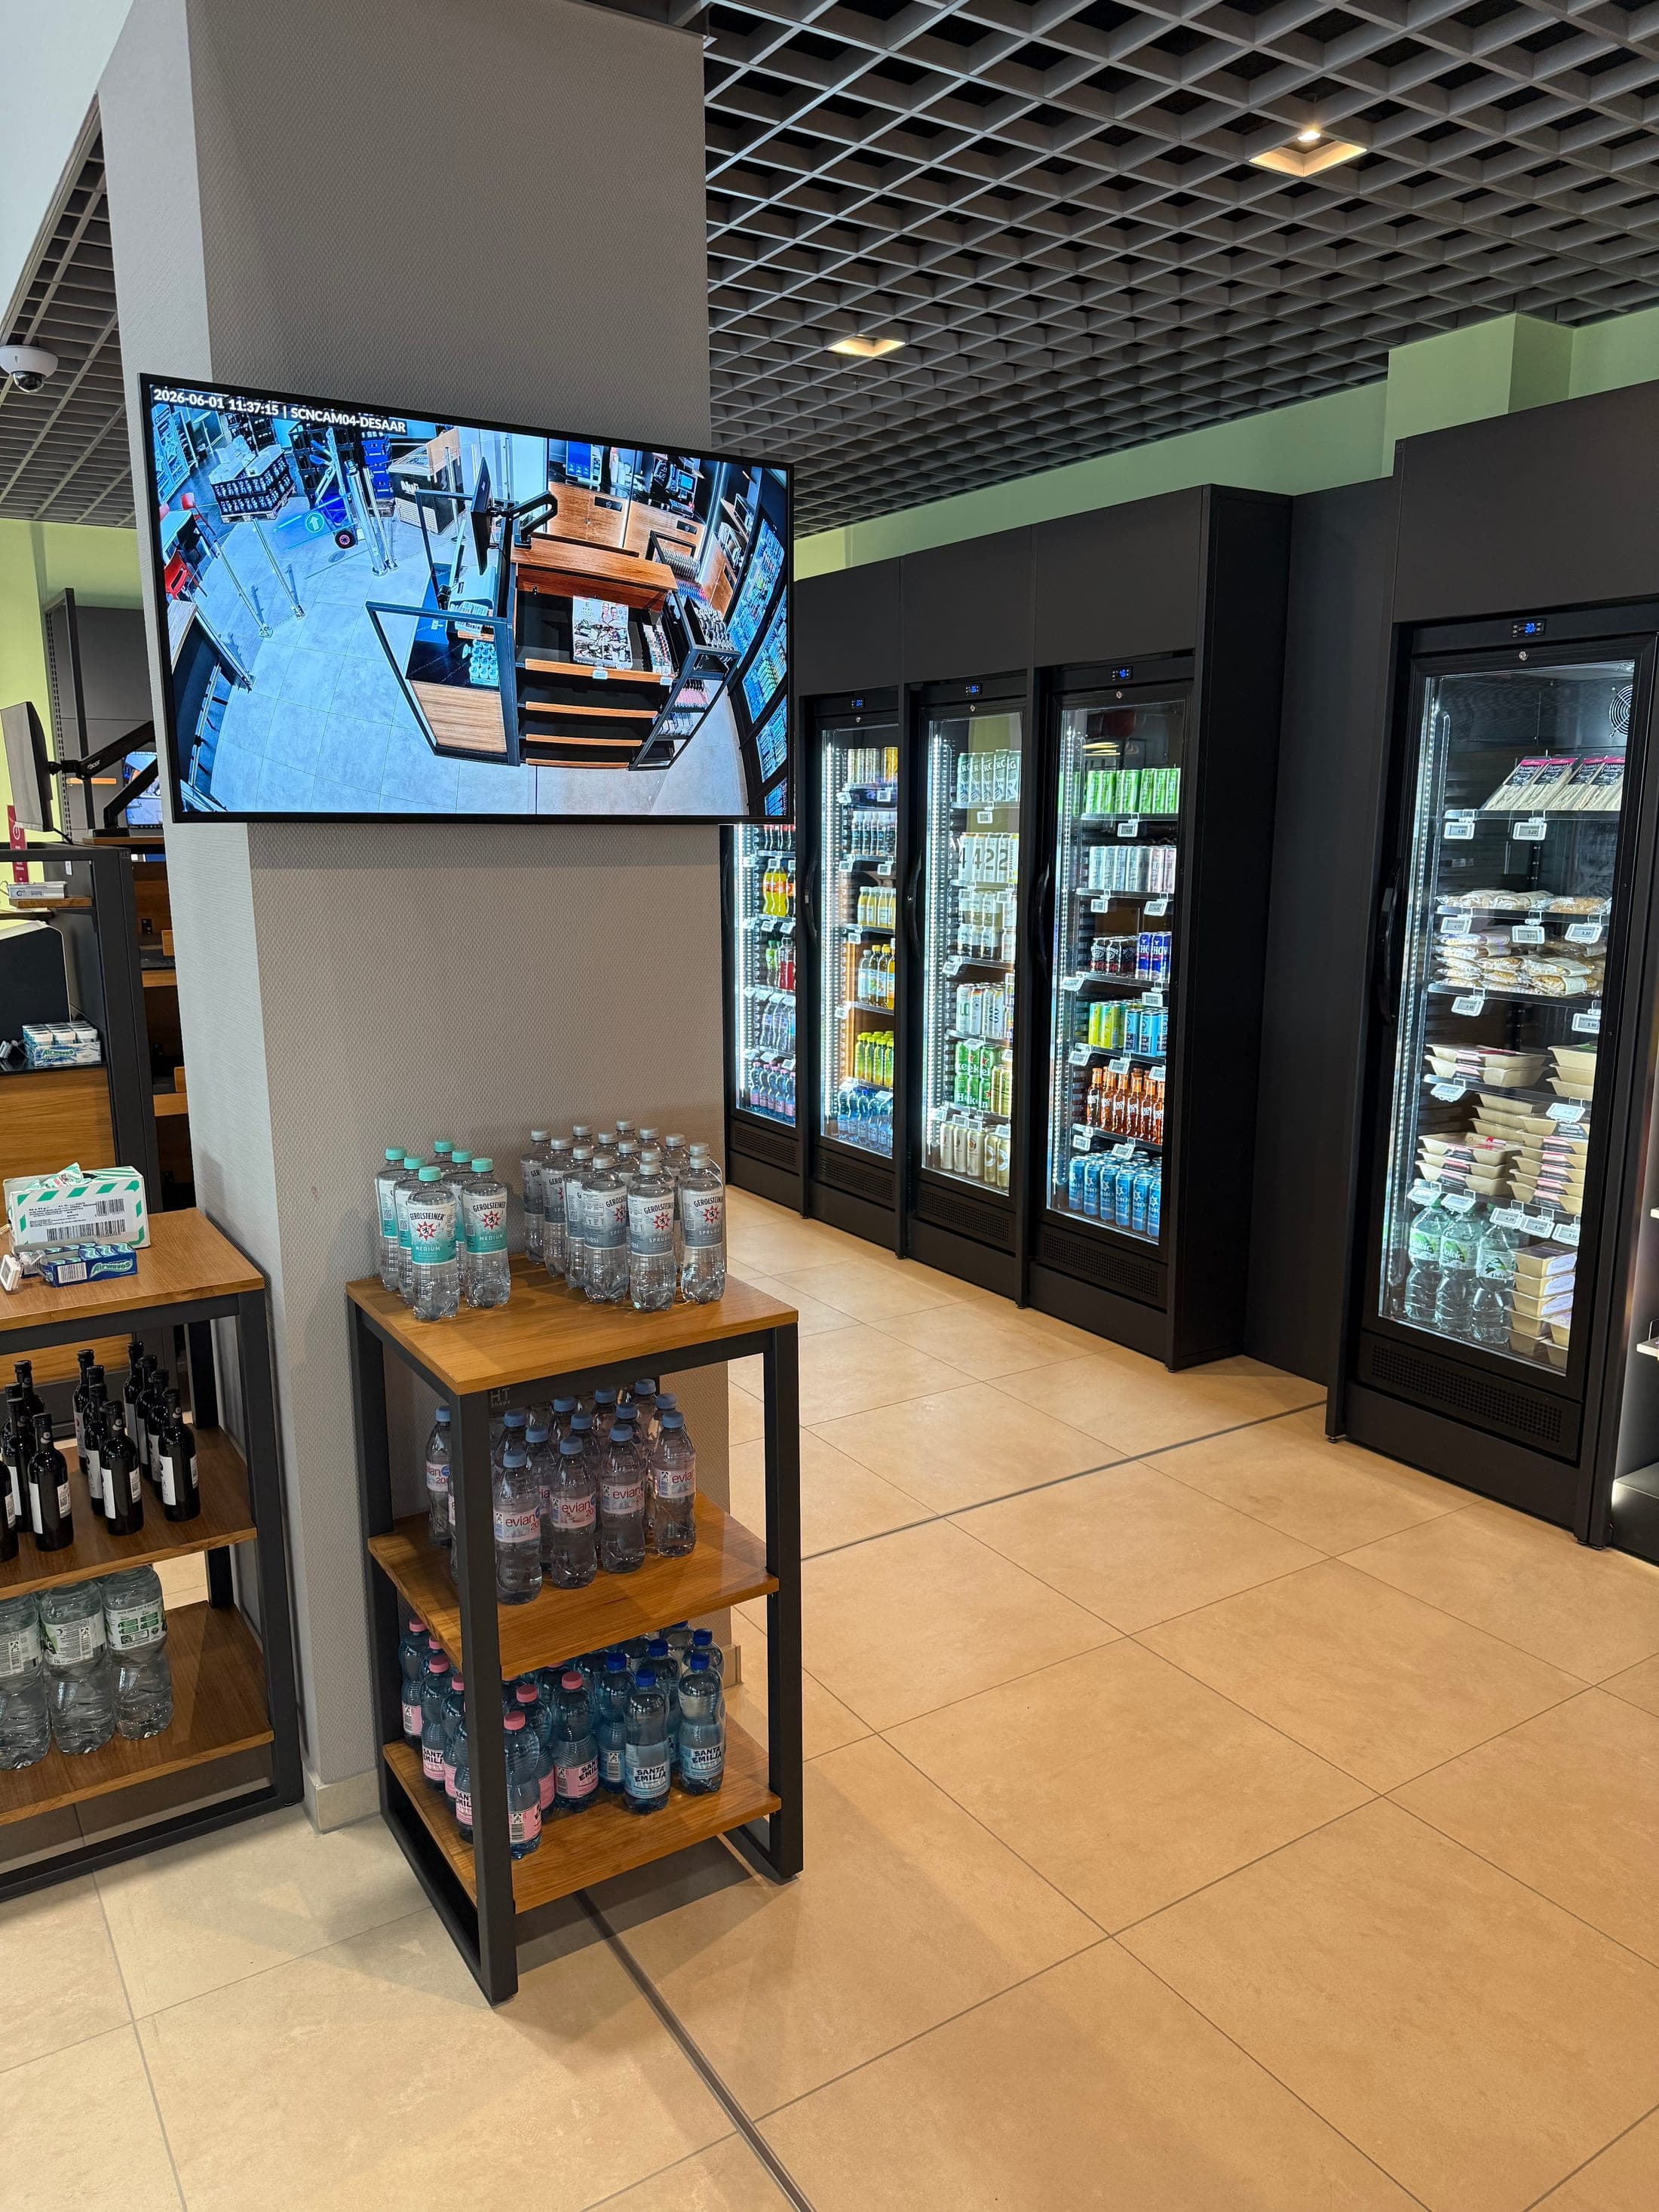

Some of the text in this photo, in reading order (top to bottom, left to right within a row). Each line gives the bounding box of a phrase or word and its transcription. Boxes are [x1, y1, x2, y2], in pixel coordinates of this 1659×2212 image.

[153, 388, 225, 409] 2026-06-01
[228, 399, 279, 416] 11:37:15
[290, 407, 406, 433] SCNCAM04-DESAAR
[612, 1486, 640, 1499] evian
[561, 1498, 591, 1513] evian
[505, 1513, 535, 1527] evian
[692, 1750, 722, 1763] EMILIA
[695, 1746, 721, 1756] SANTA
[581, 1760, 596, 1773] SAN
[636, 1766, 664, 1775] SANTA
[634, 1772, 666, 1782] EMILIA
